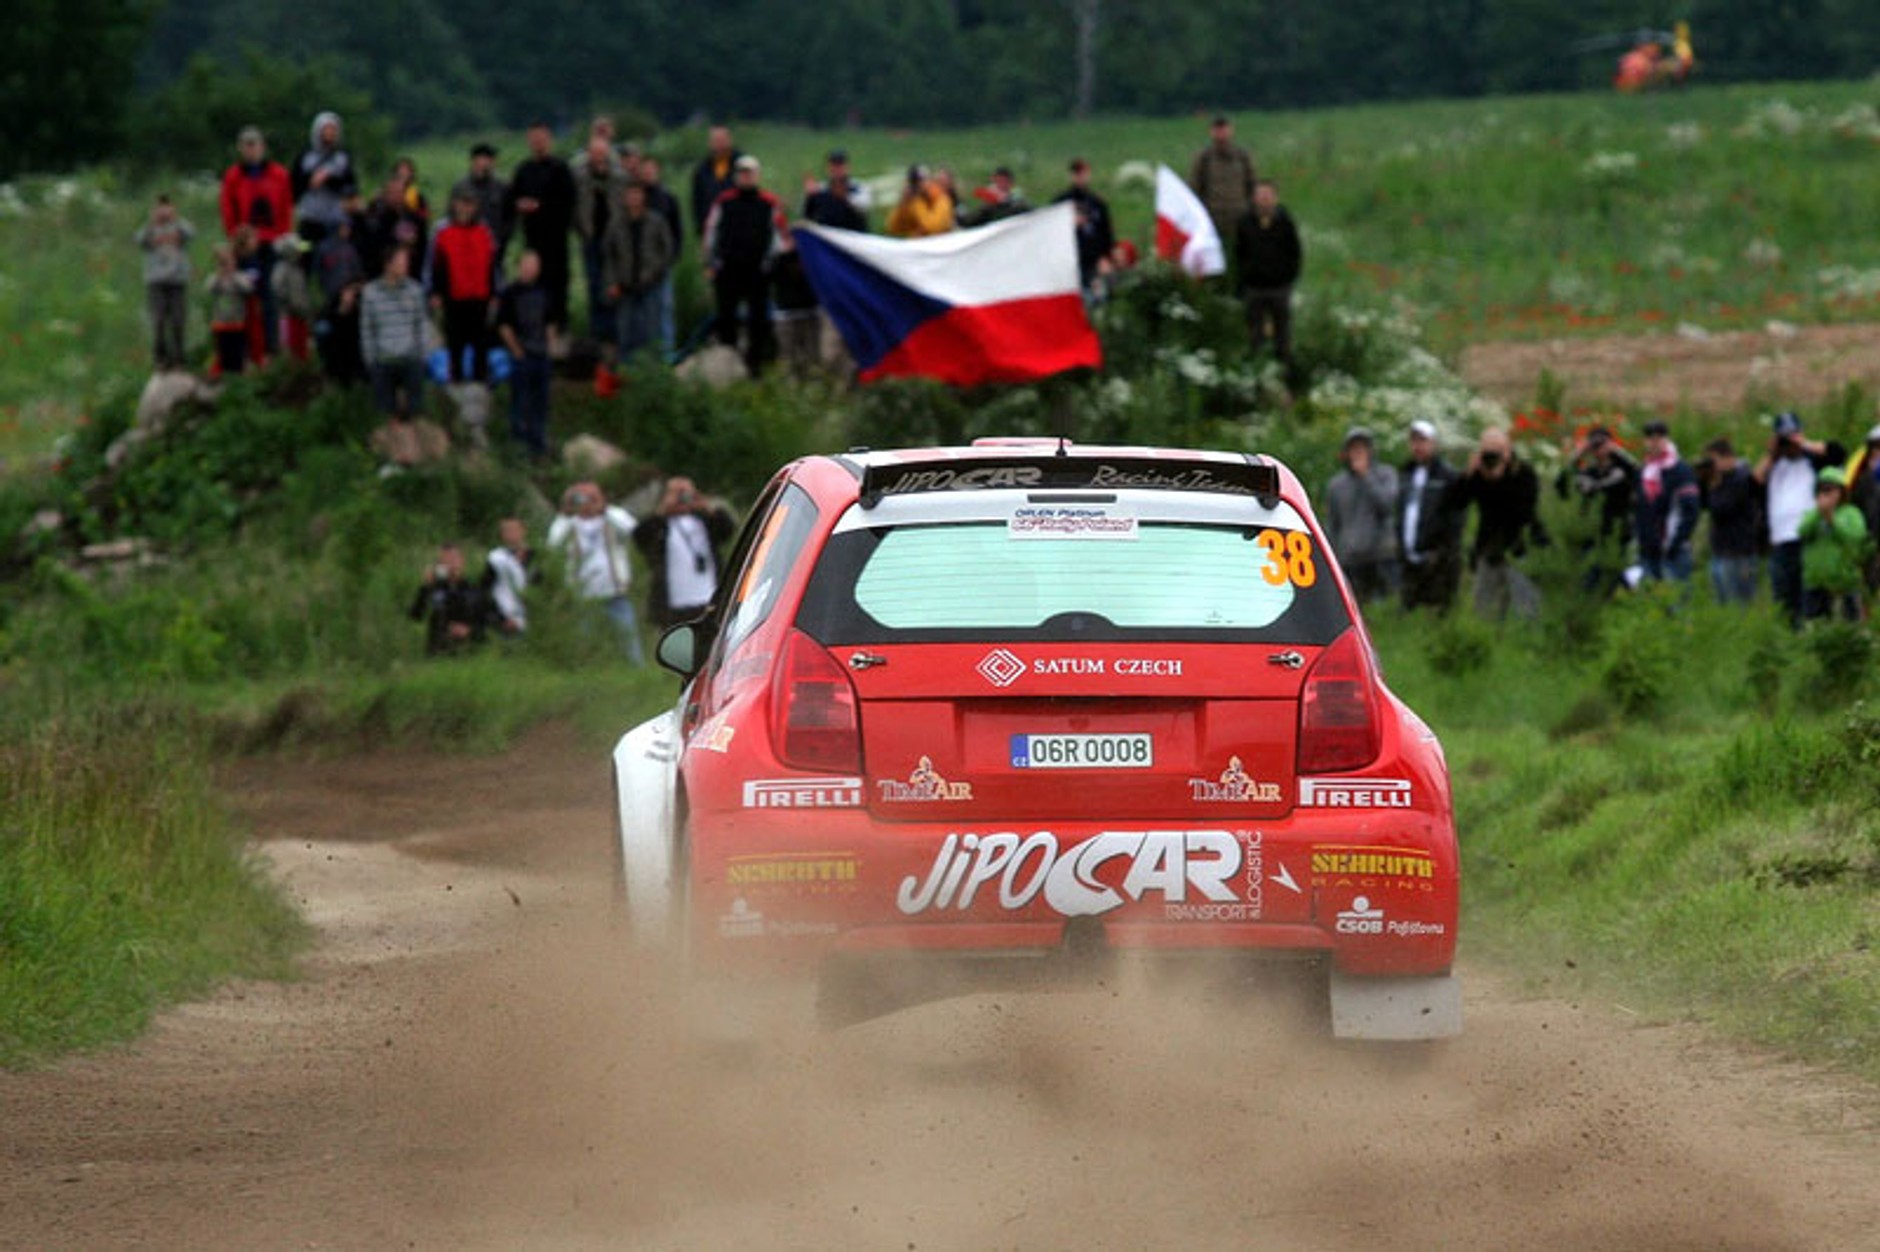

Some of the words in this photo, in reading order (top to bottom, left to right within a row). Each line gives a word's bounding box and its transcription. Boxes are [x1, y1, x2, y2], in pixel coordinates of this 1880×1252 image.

[881, 467, 1042, 494] JIPOCAR
[1089, 465, 1185, 488] Racing
[1185, 470, 1251, 494] Team
[1015, 508, 1056, 518] ORLEN
[1057, 508, 1106, 518] Platinum
[1256, 528, 1316, 588] 38
[1033, 658, 1105, 675] SATUM
[1113, 659, 1183, 676] CZECH
[1031, 739, 1080, 762] 06R
[1085, 738, 1148, 762] 0008
[742, 777, 863, 808] PIRELLI
[1299, 777, 1412, 808] PIRELLI
[1247, 831, 1262, 909] LOGISTIC
[1311, 877, 1434, 892] RACING
[1165, 904, 1247, 920] TRANSPORT
